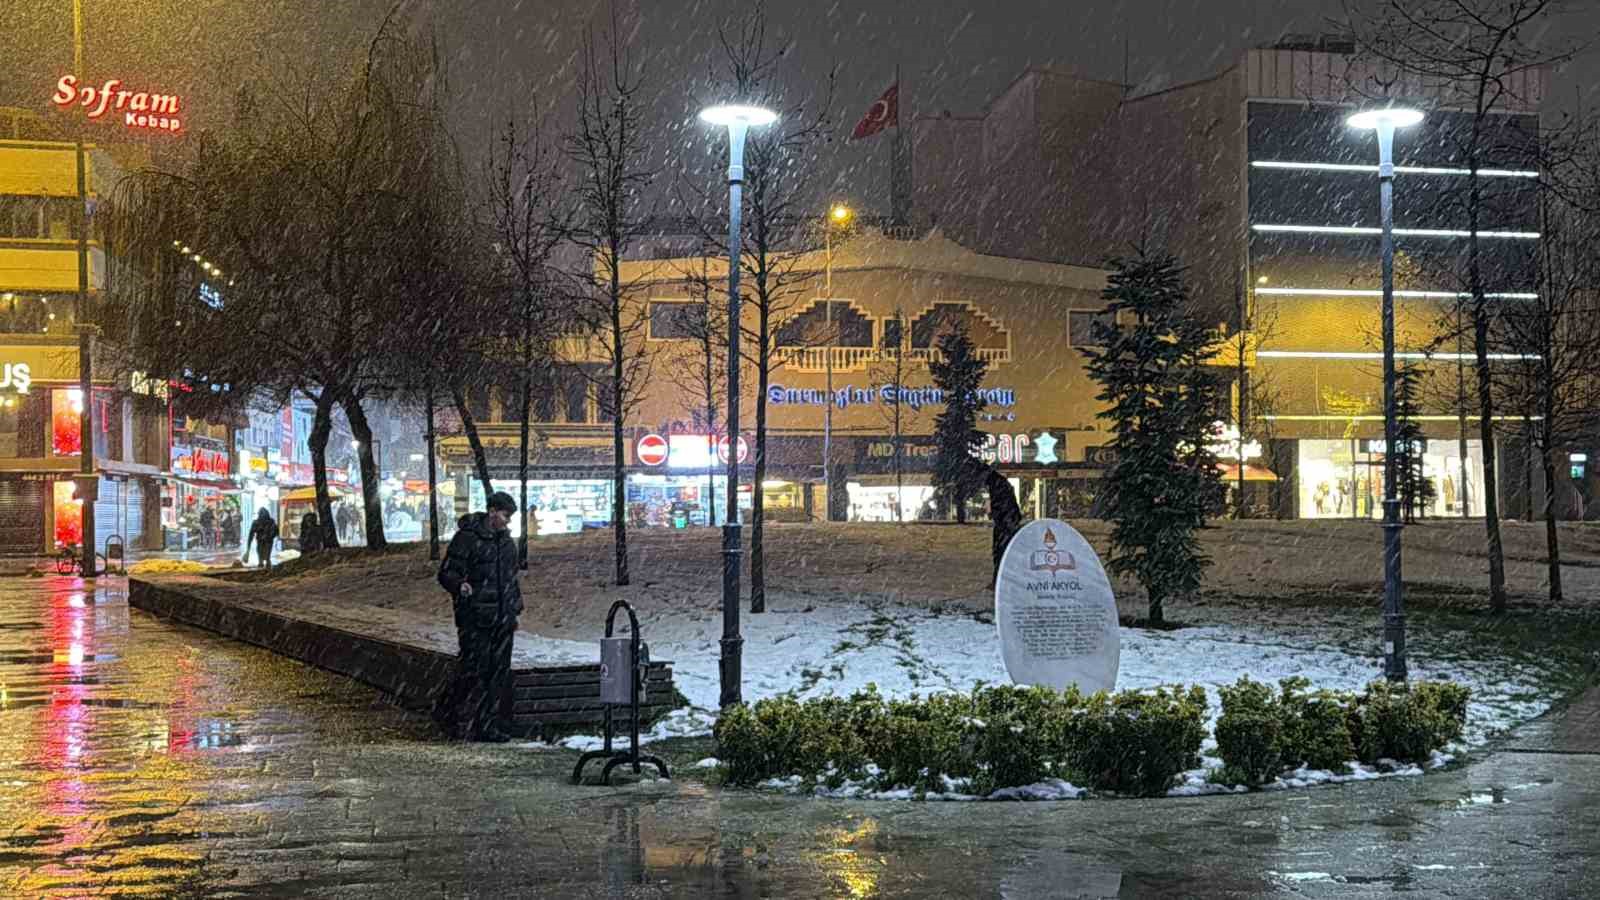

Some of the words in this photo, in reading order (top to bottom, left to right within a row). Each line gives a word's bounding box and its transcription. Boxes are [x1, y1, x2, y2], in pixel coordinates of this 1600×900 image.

[53, 75, 180, 118] Sofram
[125, 112, 180, 131] Kebap
[1051, 582, 1083, 591] AKYOL
